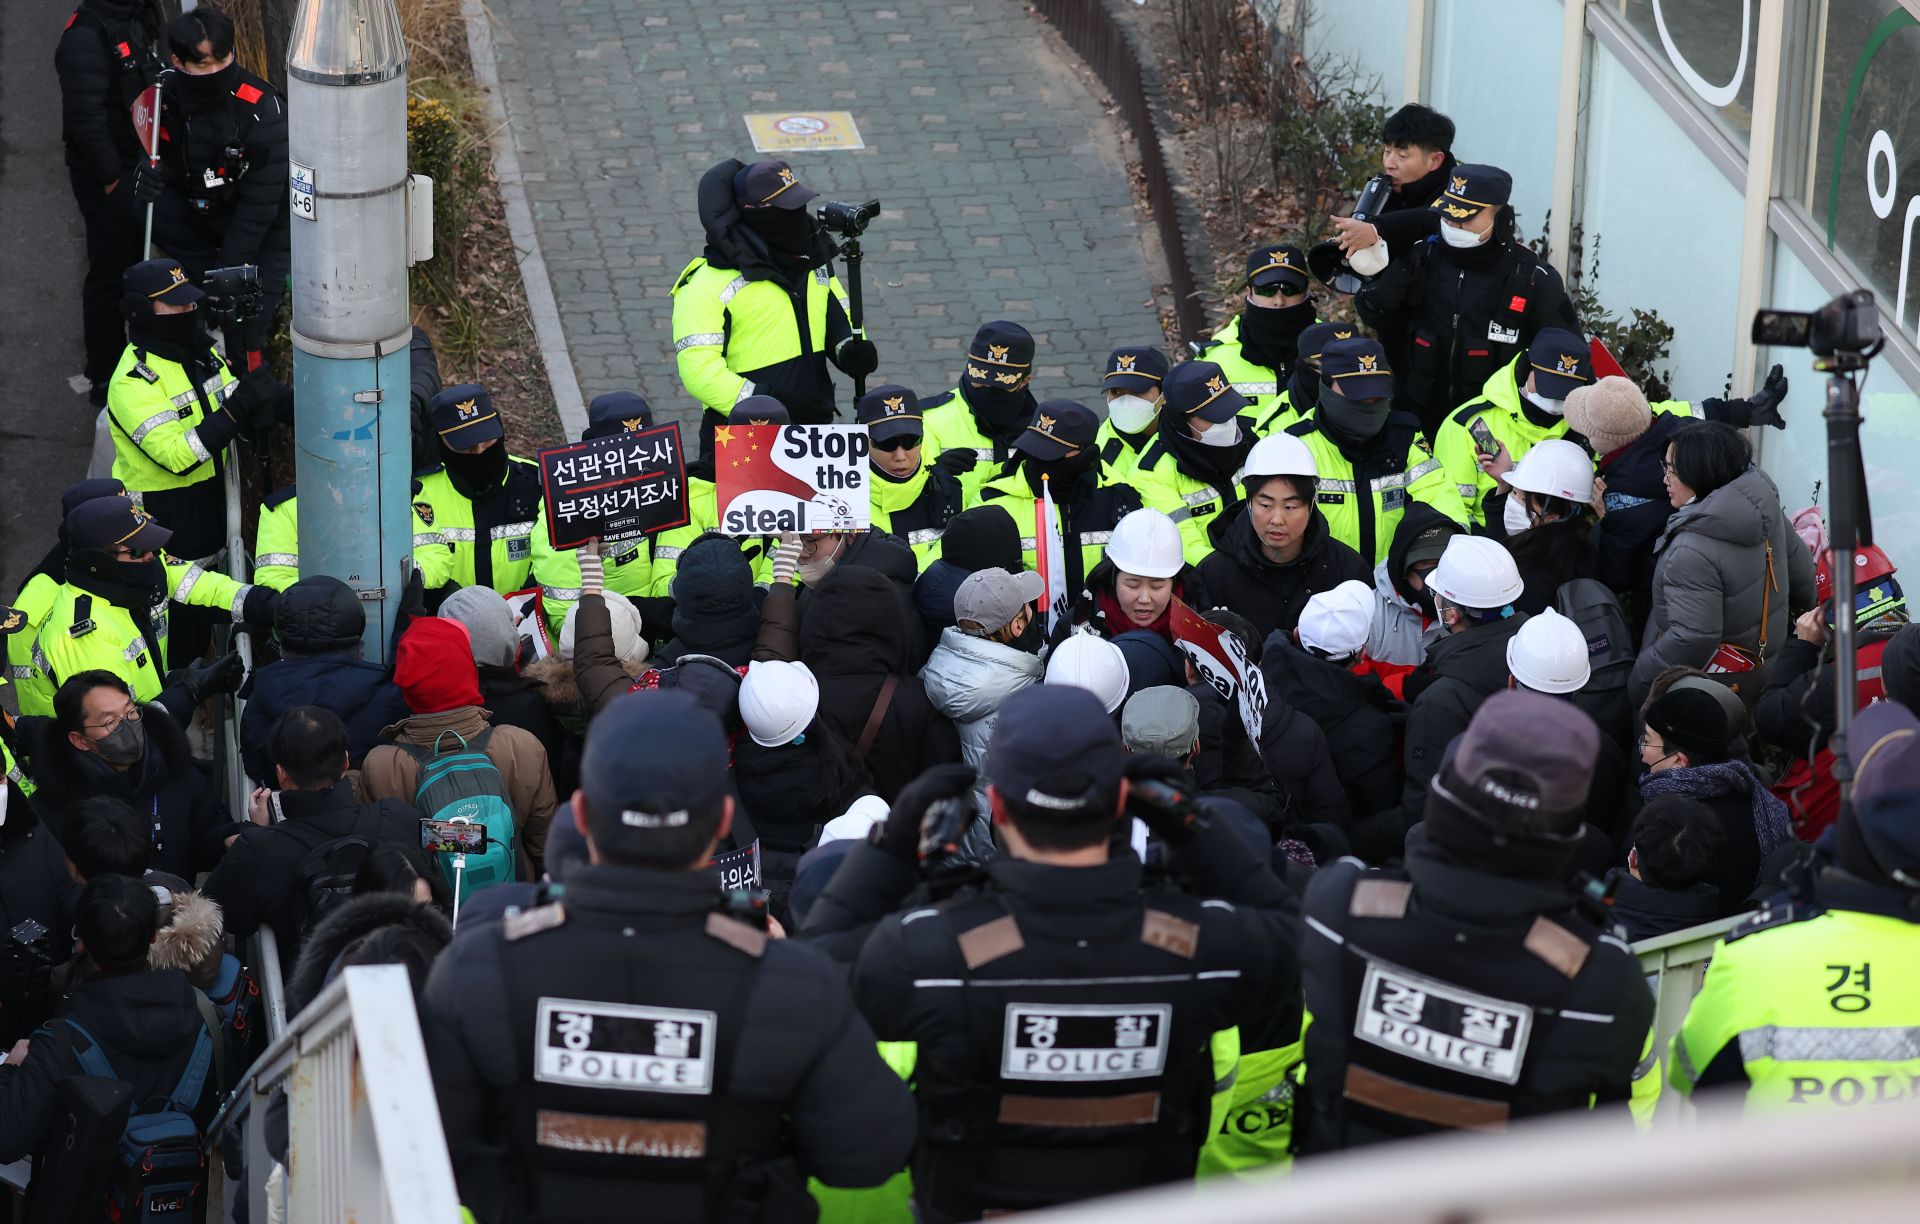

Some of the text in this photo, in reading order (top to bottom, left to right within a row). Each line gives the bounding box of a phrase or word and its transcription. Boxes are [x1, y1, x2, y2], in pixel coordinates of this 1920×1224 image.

[293, 192, 312, 213] 4-6
[784, 425, 869, 467] Stop
[553, 437, 673, 486] 선관위수사
[816, 465, 861, 489] the
[557, 478, 679, 523] 부정선거조사
[726, 502, 805, 533] steal
[603, 529, 642, 542] SAVE KOREA
[1484, 780, 1540, 810] POLICE
[1826, 962, 1871, 1013] 경
[1380, 1020, 1497, 1069] POLICE
[558, 1054, 688, 1083] POLICE
[1025, 1052, 1144, 1072] POLICE
